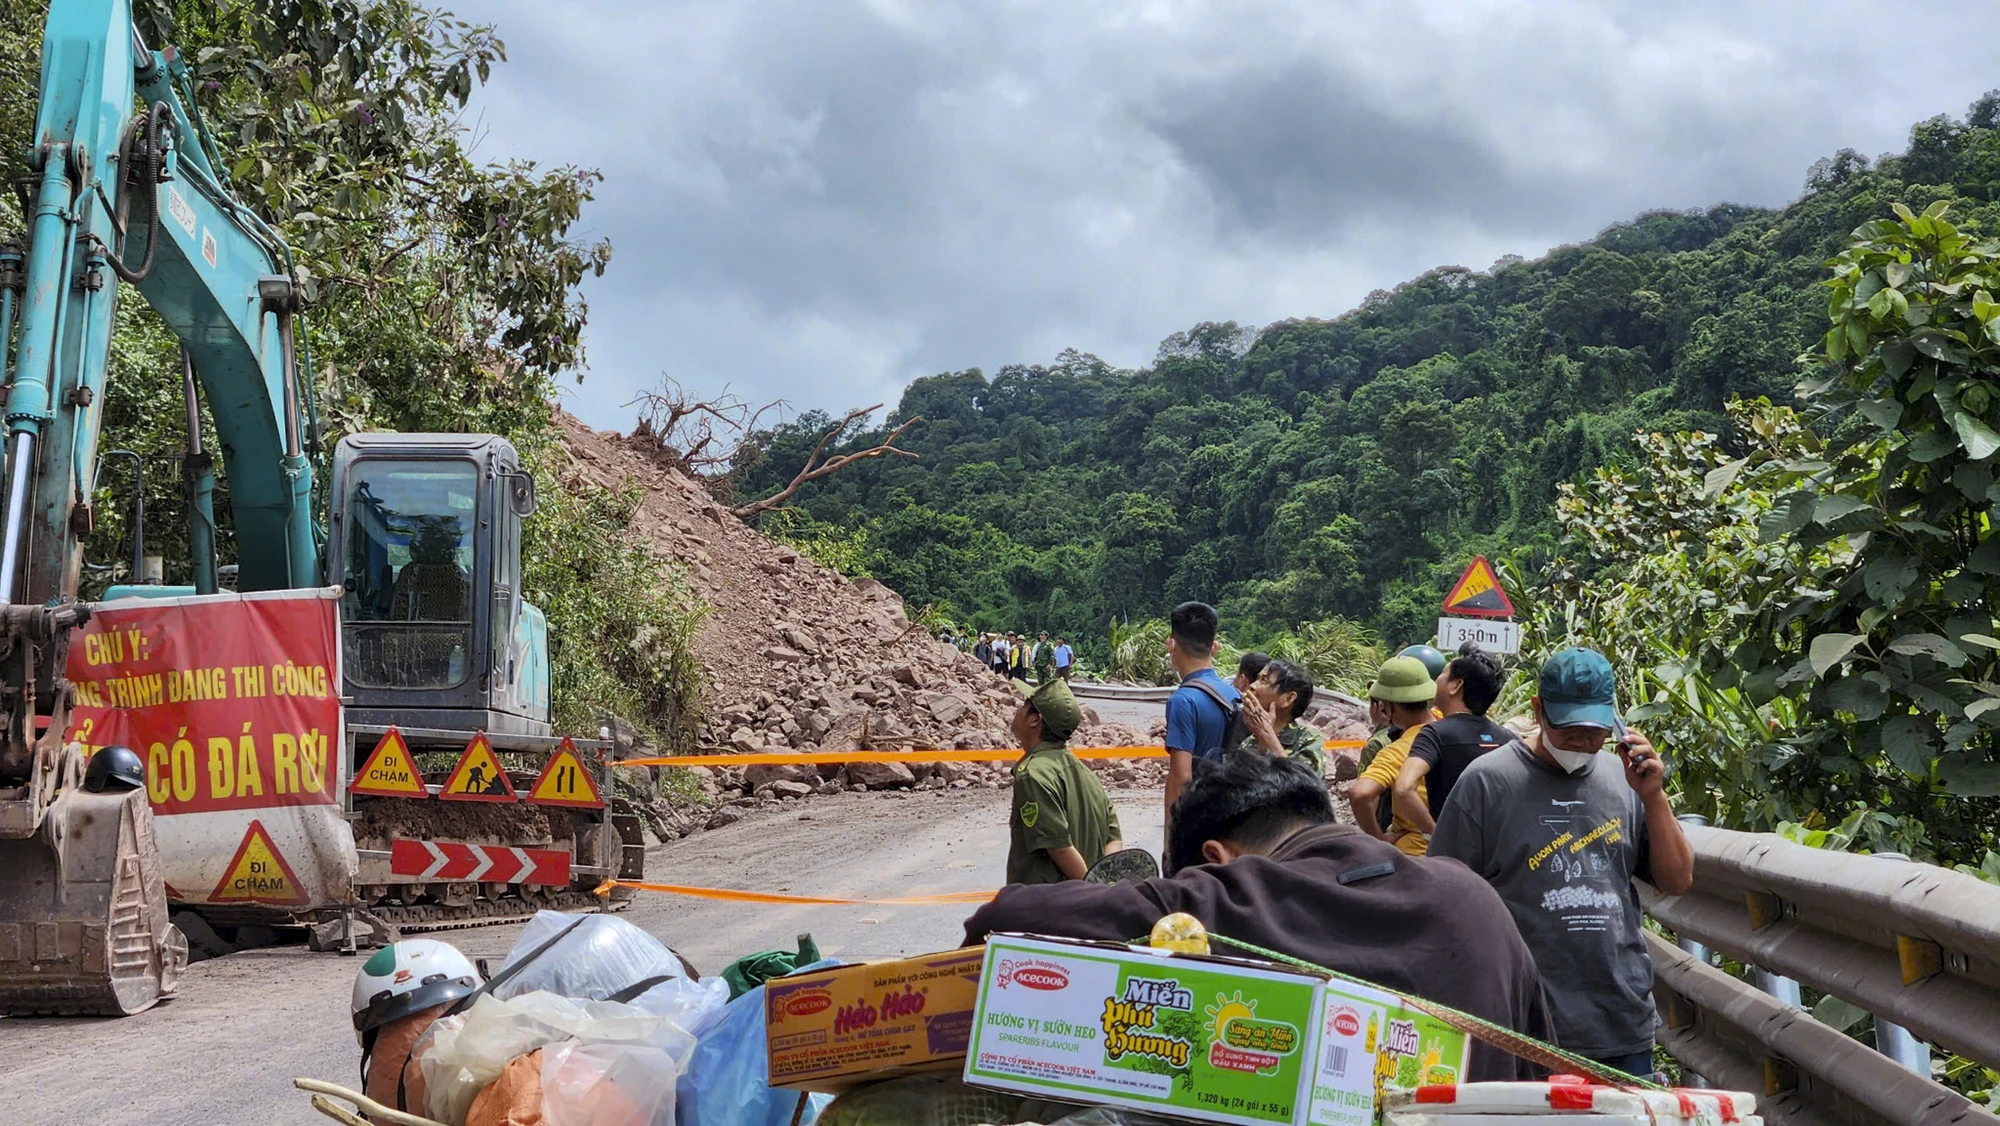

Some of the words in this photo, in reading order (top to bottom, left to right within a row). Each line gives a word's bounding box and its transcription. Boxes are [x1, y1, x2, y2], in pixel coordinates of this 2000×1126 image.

[85, 625, 124, 666] CHÚ
[128, 623, 149, 661] Ý:
[71, 681, 104, 708] NG
[106, 671, 163, 708] TRÌNH
[168, 667, 227, 702] ĐANG
[231, 665, 266, 698] THI
[272, 659, 328, 698] CÔNG
[148, 726, 196, 804] CÓ
[208, 721, 263, 799] ĐÁ
[272, 728, 328, 794] RƠI
[384, 756, 397, 767] ĐI
[1569, 817, 1622, 854] ARCHAEOLOGY
[1528, 845, 1553, 871] AVON
[1551, 831, 1573, 850] PARK
[250, 861, 266, 874] ĐI
[919, 971, 937, 980] CÔNG
[1015, 959, 1034, 968] Cook
[1035, 959, 1071, 976] happiness
[834, 997, 877, 1035] Hảo
[880, 984, 925, 1022] Hảo
[1100, 996, 1155, 1033] Phú
[987, 1012, 1025, 1029] HƯƠNG
[1028, 1018, 1040, 1034] VỊ
[1043, 1020, 1072, 1036] SƯỜN
[1074, 1025, 1096, 1039] HEO
[998, 1033, 1040, 1047] SPARERIBS
[1041, 1039, 1080, 1052] FLAVOUR
[981, 1052, 998, 1061] CÔNG
[1008, 1054, 1018, 1064] CỔ
[1018, 1056, 1035, 1066] PHẦN
[1036, 1061, 1065, 1071] ACECOOK
[1066, 1065, 1081, 1074] VIỆT
[1225, 1052, 1243, 1061] SUNG
[1245, 1055, 1260, 1063] TINH
[1232, 1061, 1256, 1071] XANH
[1197, 1092, 1218, 1104] 1,320
[1220, 1095, 1229, 1107] kg
[1231, 1098, 1244, 1109] (24
[1269, 1103, 1279, 1113] 55
